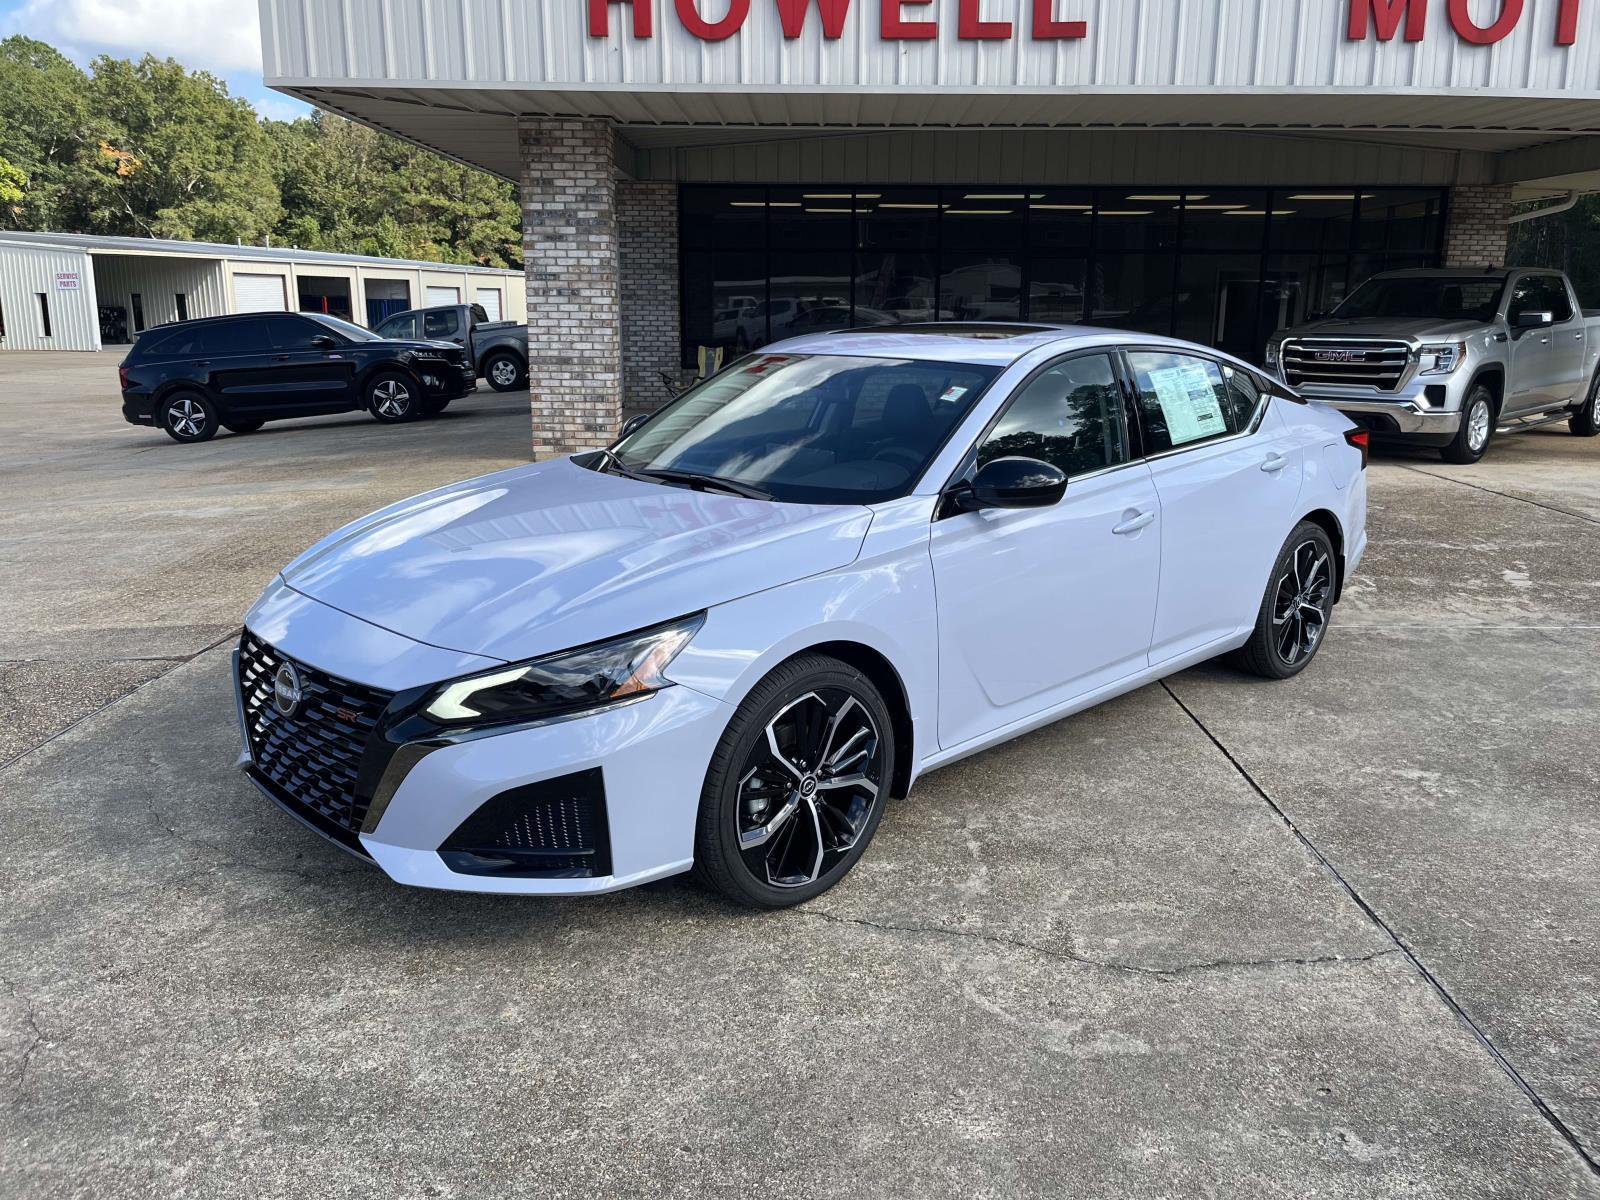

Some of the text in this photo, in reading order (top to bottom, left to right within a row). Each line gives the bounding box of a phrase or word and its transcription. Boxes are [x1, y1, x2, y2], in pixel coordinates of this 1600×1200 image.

[589, 0, 1087, 42] HOWELL
[59, 280, 77, 288] PARTS
[1315, 351, 1366, 362] GMC
